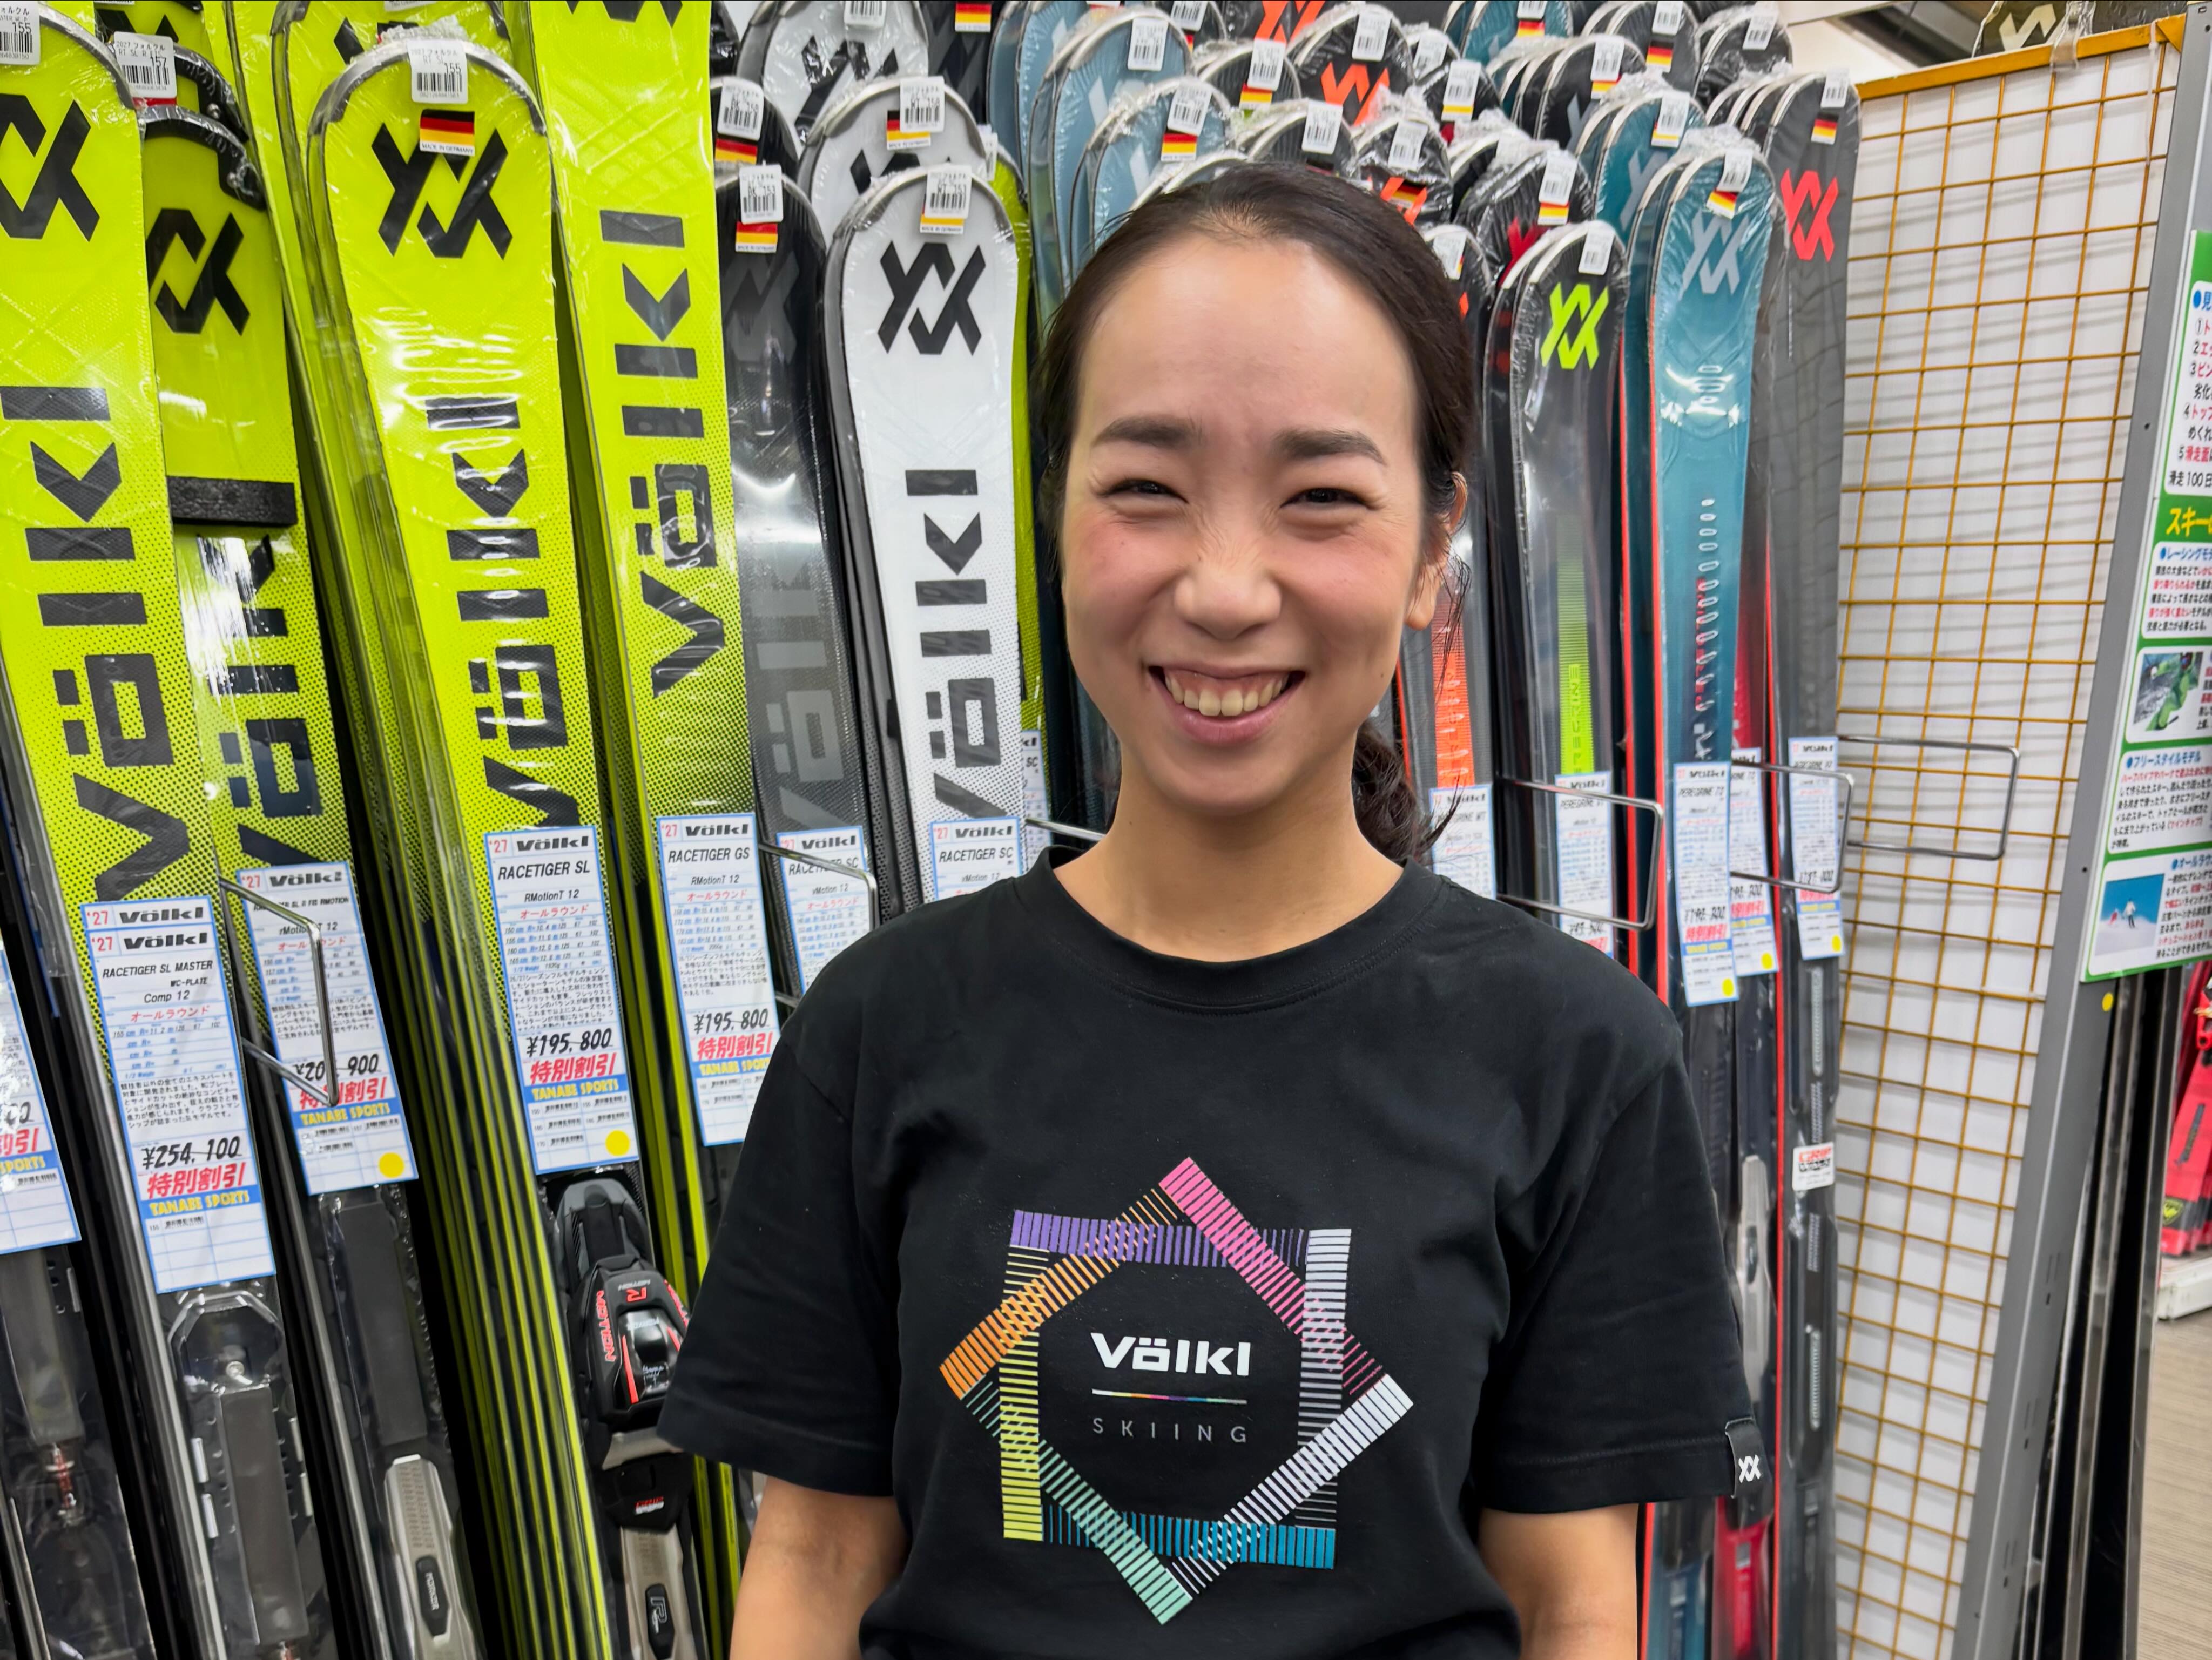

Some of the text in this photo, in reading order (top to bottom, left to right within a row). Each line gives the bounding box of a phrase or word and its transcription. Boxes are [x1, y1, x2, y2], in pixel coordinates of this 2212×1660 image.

[150, 56, 167, 67] 157
[444, 62, 461, 74] 155
[2193, 383, 2212, 400] 劣化
[599, 210, 725, 699] Völkl
[1, 386, 190, 901] Völkl
[685, 824, 749, 836] Völkl
[955, 825, 1013, 839] Völkl
[516, 835, 589, 852] Völkl
[801, 835, 857, 851] Völkl
[668, 847, 750, 863] RACETIGER GS
[846, 856, 859, 869] SC
[939, 846, 1014, 863] RACETIGER SC
[497, 860, 591, 880] RACETIGER SL
[269, 871, 342, 887] Völkl
[691, 874, 740, 886] RMotionT 12
[524, 889, 579, 903] RMotionT 12
[687, 889, 748, 902] オールラウンド
[807, 896, 860, 911] オールラウンド
[119, 906, 204, 924] Völkl
[520, 903, 589, 920] オールラウンド
[326, 921, 338, 931] 12
[123, 932, 208, 950] Völkl
[278, 936, 347, 952] オールウンド
[102, 960, 213, 979] RACETIGER SL MASTER
[144, 990, 190, 1004] Comp 12
[130, 1004, 210, 1023] オールラウンド
[697, 1031, 773, 1061] 特別割引
[530, 1052, 617, 1087] 特別割引
[531, 1078, 619, 1101] TANABE SPORTS
[300, 1102, 391, 1126] TANABE SPORTS
[146, 1162, 246, 1200] 特別割引
[149, 1190, 251, 1217] TANABE SPORTS
[1090, 1332, 1251, 1376] Völkl
[1092, 1417, 1247, 1443] SKIING
